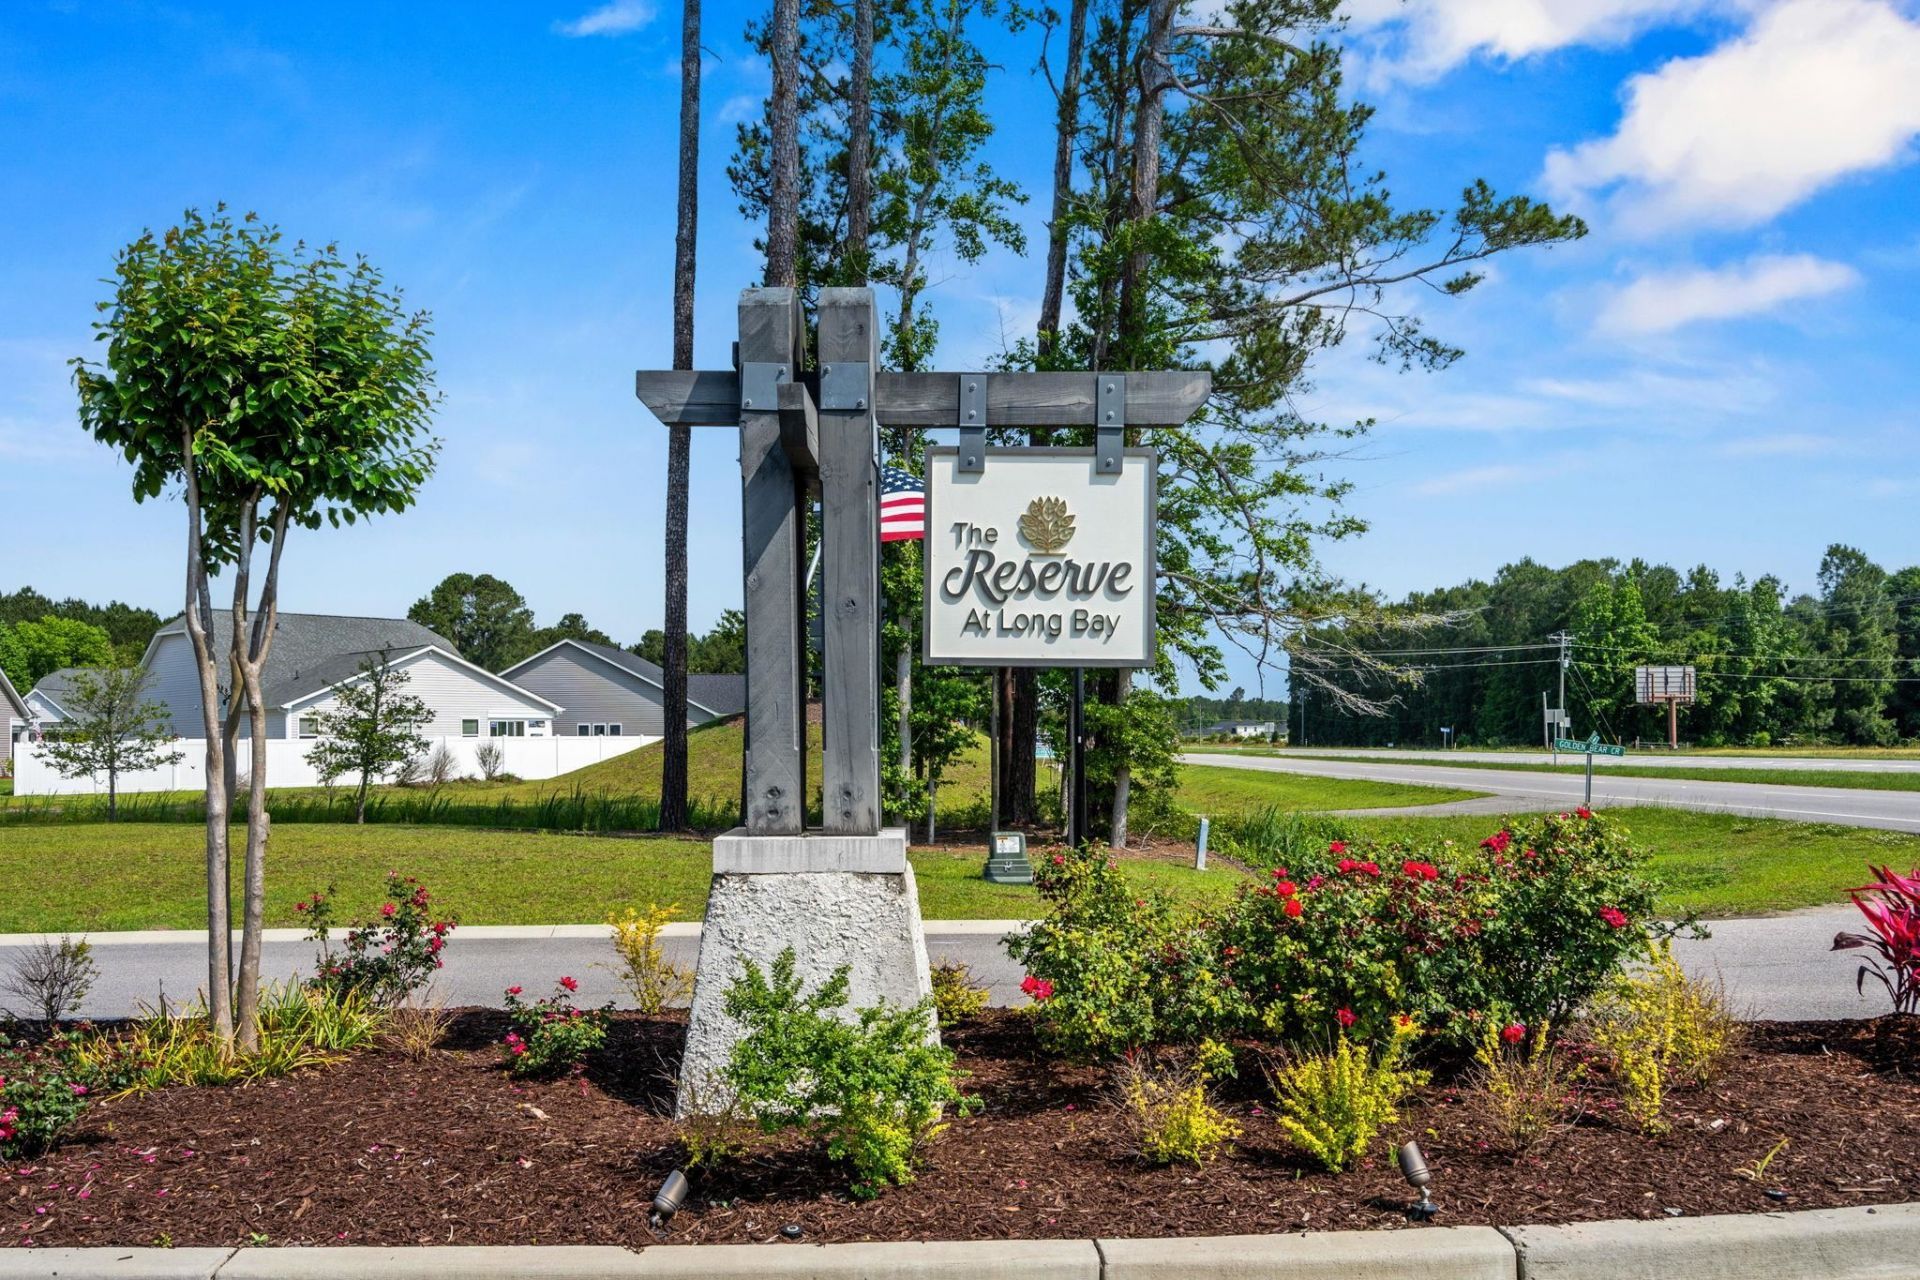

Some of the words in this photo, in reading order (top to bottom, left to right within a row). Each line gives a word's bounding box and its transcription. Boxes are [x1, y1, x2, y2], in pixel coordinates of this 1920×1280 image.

[953, 522, 998, 544] The
[944, 549, 1134, 604] Reserve
[963, 607, 991, 631] At
[1000, 608, 1062, 637] Long
[1073, 608, 1121, 639] Bay
[1559, 740, 1586, 751] GOLDEN
[1589, 745, 1608, 753] BEAR
[1611, 747, 1621, 755] CR
